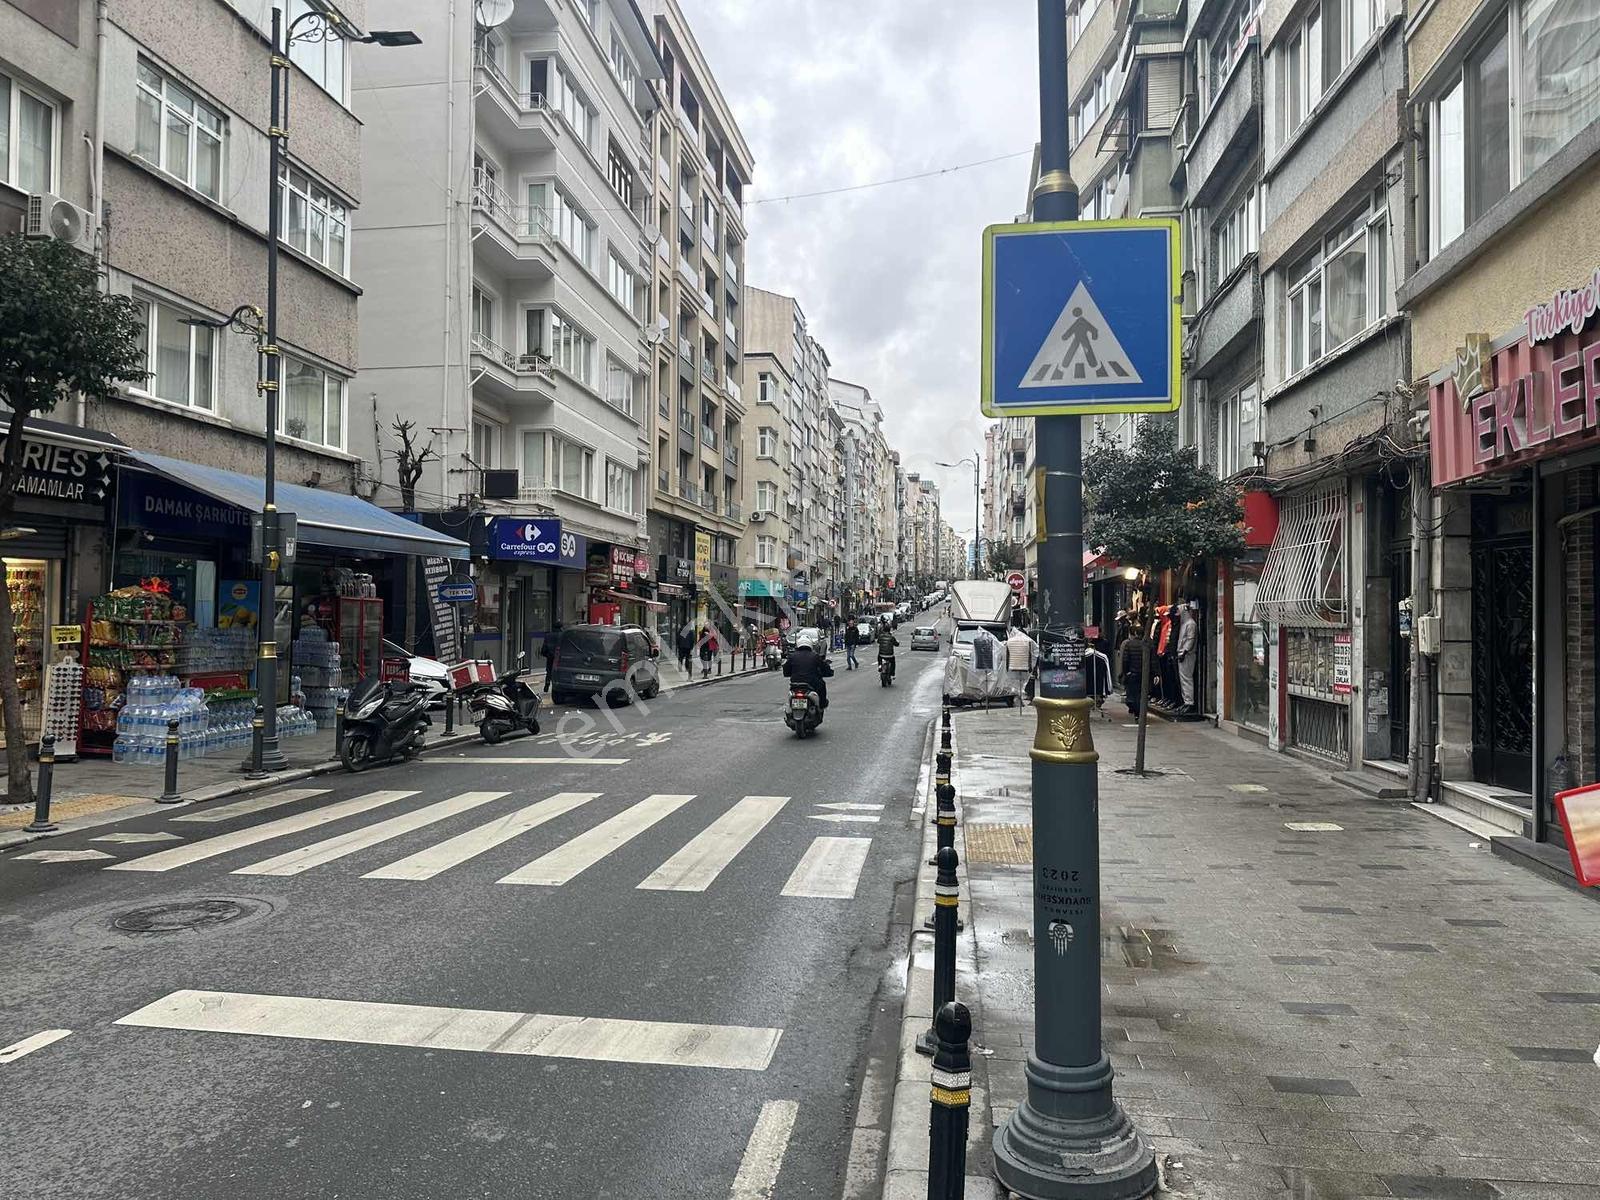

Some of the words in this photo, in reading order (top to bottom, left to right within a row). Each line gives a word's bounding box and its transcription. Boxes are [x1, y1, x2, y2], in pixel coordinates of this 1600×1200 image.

[145, 496, 193, 518] DAMAK
[195, 503, 252, 526] ŞARKÜTE
[561, 533, 576, 558] SA
